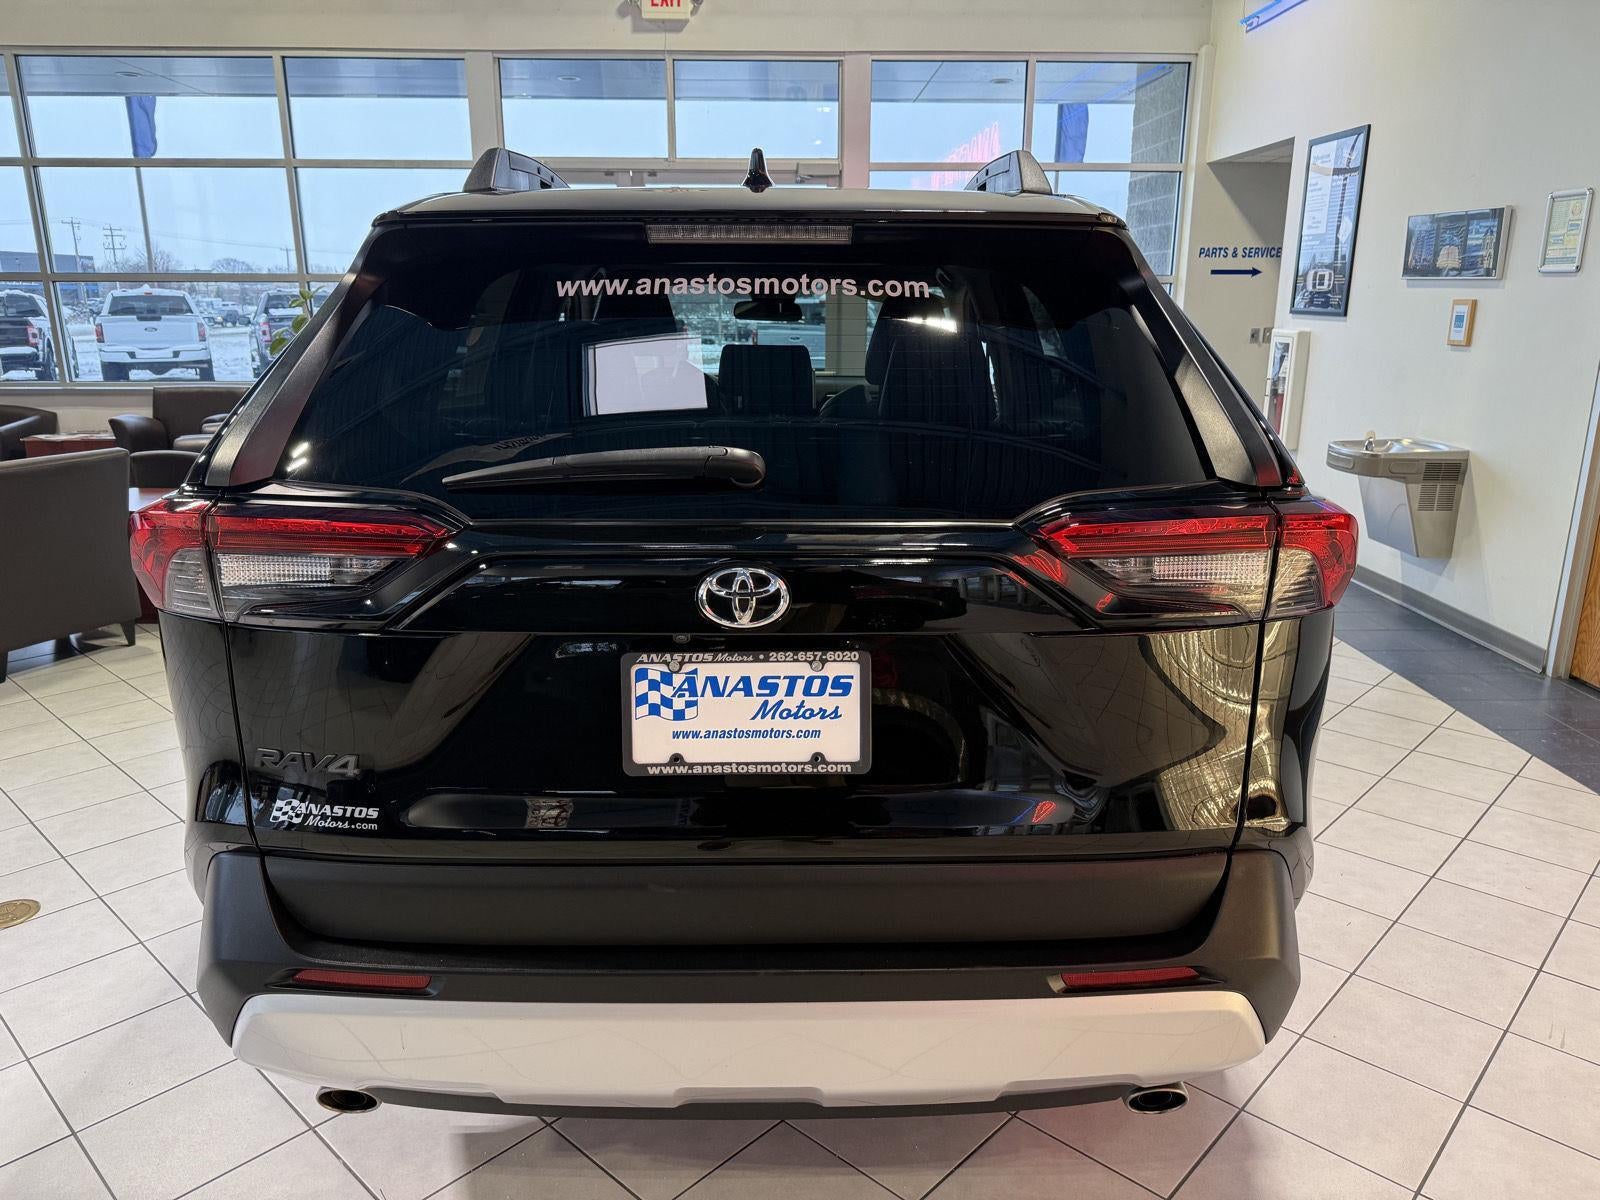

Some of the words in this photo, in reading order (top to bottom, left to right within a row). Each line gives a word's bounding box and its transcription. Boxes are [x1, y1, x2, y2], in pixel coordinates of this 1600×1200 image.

[1198, 247, 1229, 258] PARTS
[1231, 247, 1238, 258] &
[1241, 247, 1282, 258] SERVICE
[556, 273, 930, 298] www.anastosmotors.com
[636, 653, 713, 663] ANASTOS
[713, 653, 754, 662] Motors
[769, 651, 859, 662] 262-657-6020
[671, 675, 854, 698] ANASTOS
[750, 699, 842, 721] Motors
[672, 727, 821, 740] www.anastosmotors.com
[255, 747, 361, 777] RAV4
[647, 763, 851, 775] www.anastosmotors.com
[293, 801, 380, 819] ANASTOS
